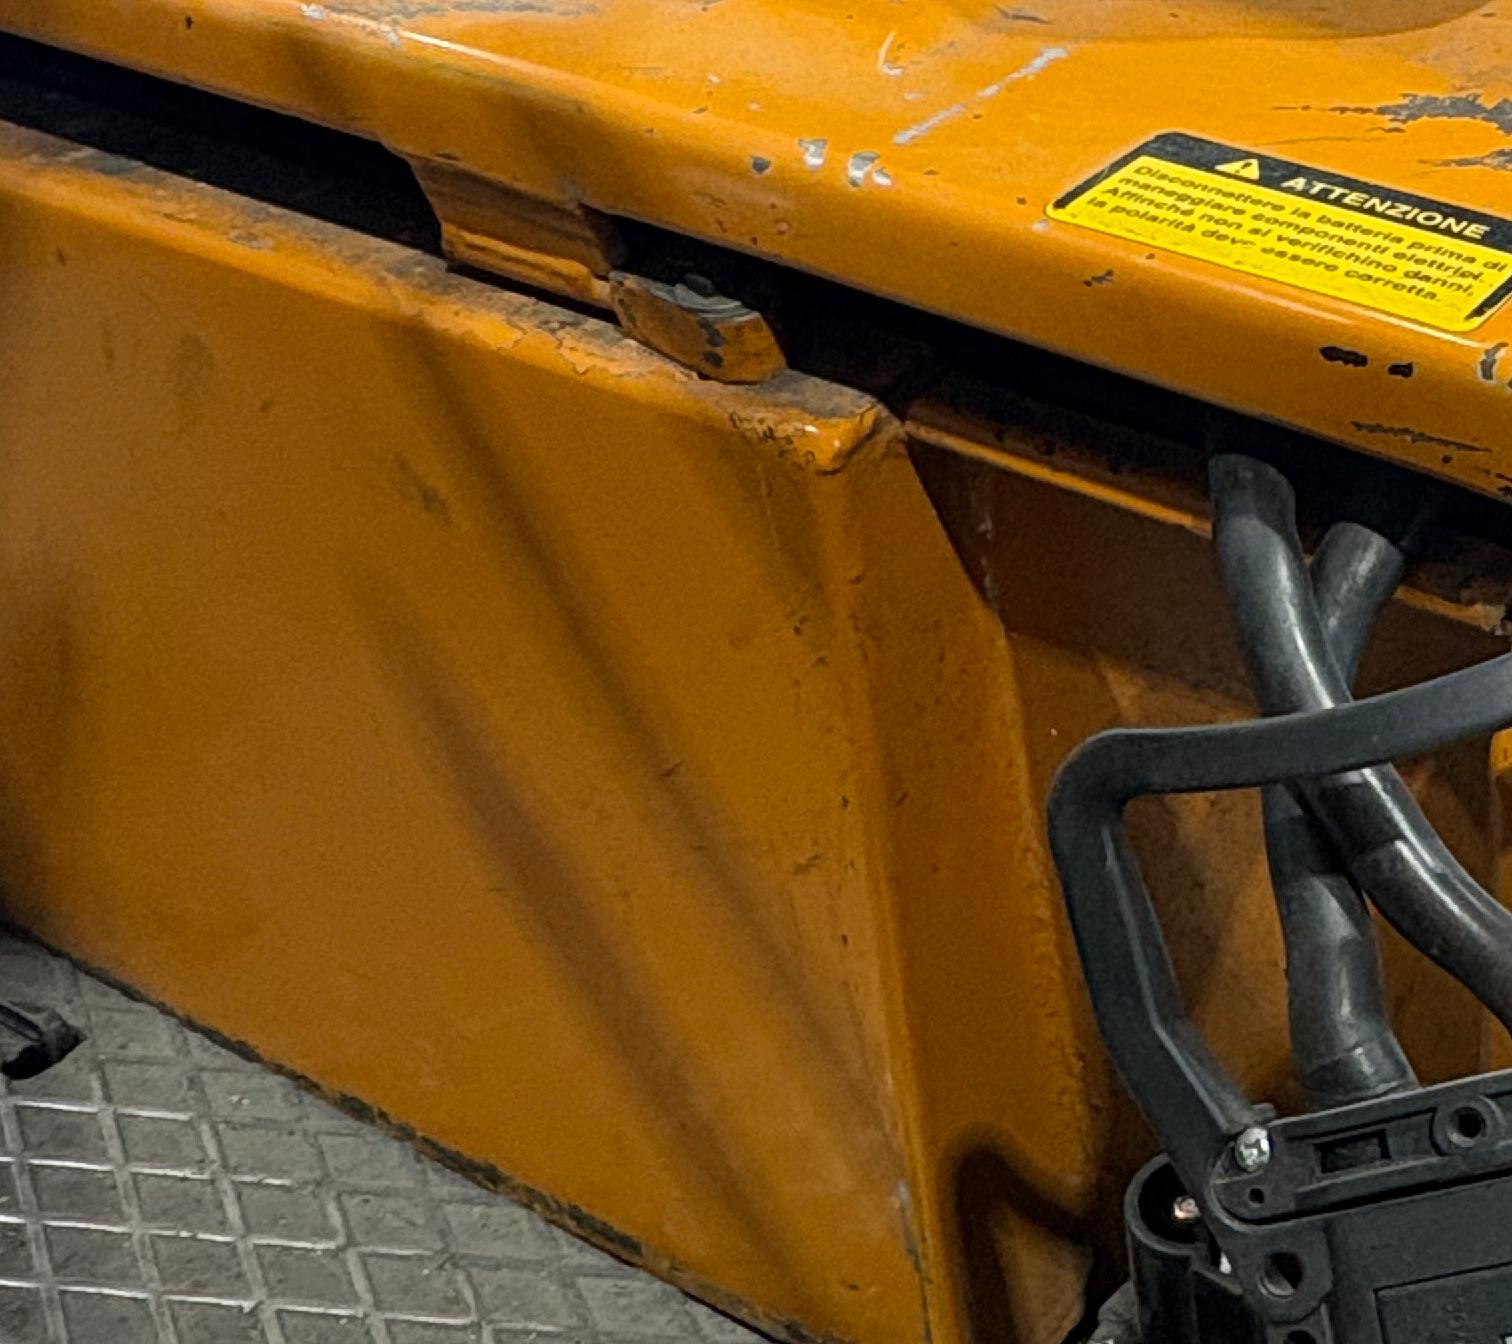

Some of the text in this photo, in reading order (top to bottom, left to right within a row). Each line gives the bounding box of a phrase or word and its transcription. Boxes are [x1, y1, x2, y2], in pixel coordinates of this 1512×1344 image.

[1085, 196, 1108, 209] la
[1259, 246, 1340, 273] essere
[1117, 176, 1247, 217] maneggiare
[1250, 212, 1391, 255] componenti
[1132, 165, 1509, 273] Disconnettere la batteria prima di
[1197, 212, 1244, 231] non
[1246, 227, 1273, 238] si
[1276, 234, 1398, 273] verifichino
[1280, 175, 1492, 241] ATTENZIONE
